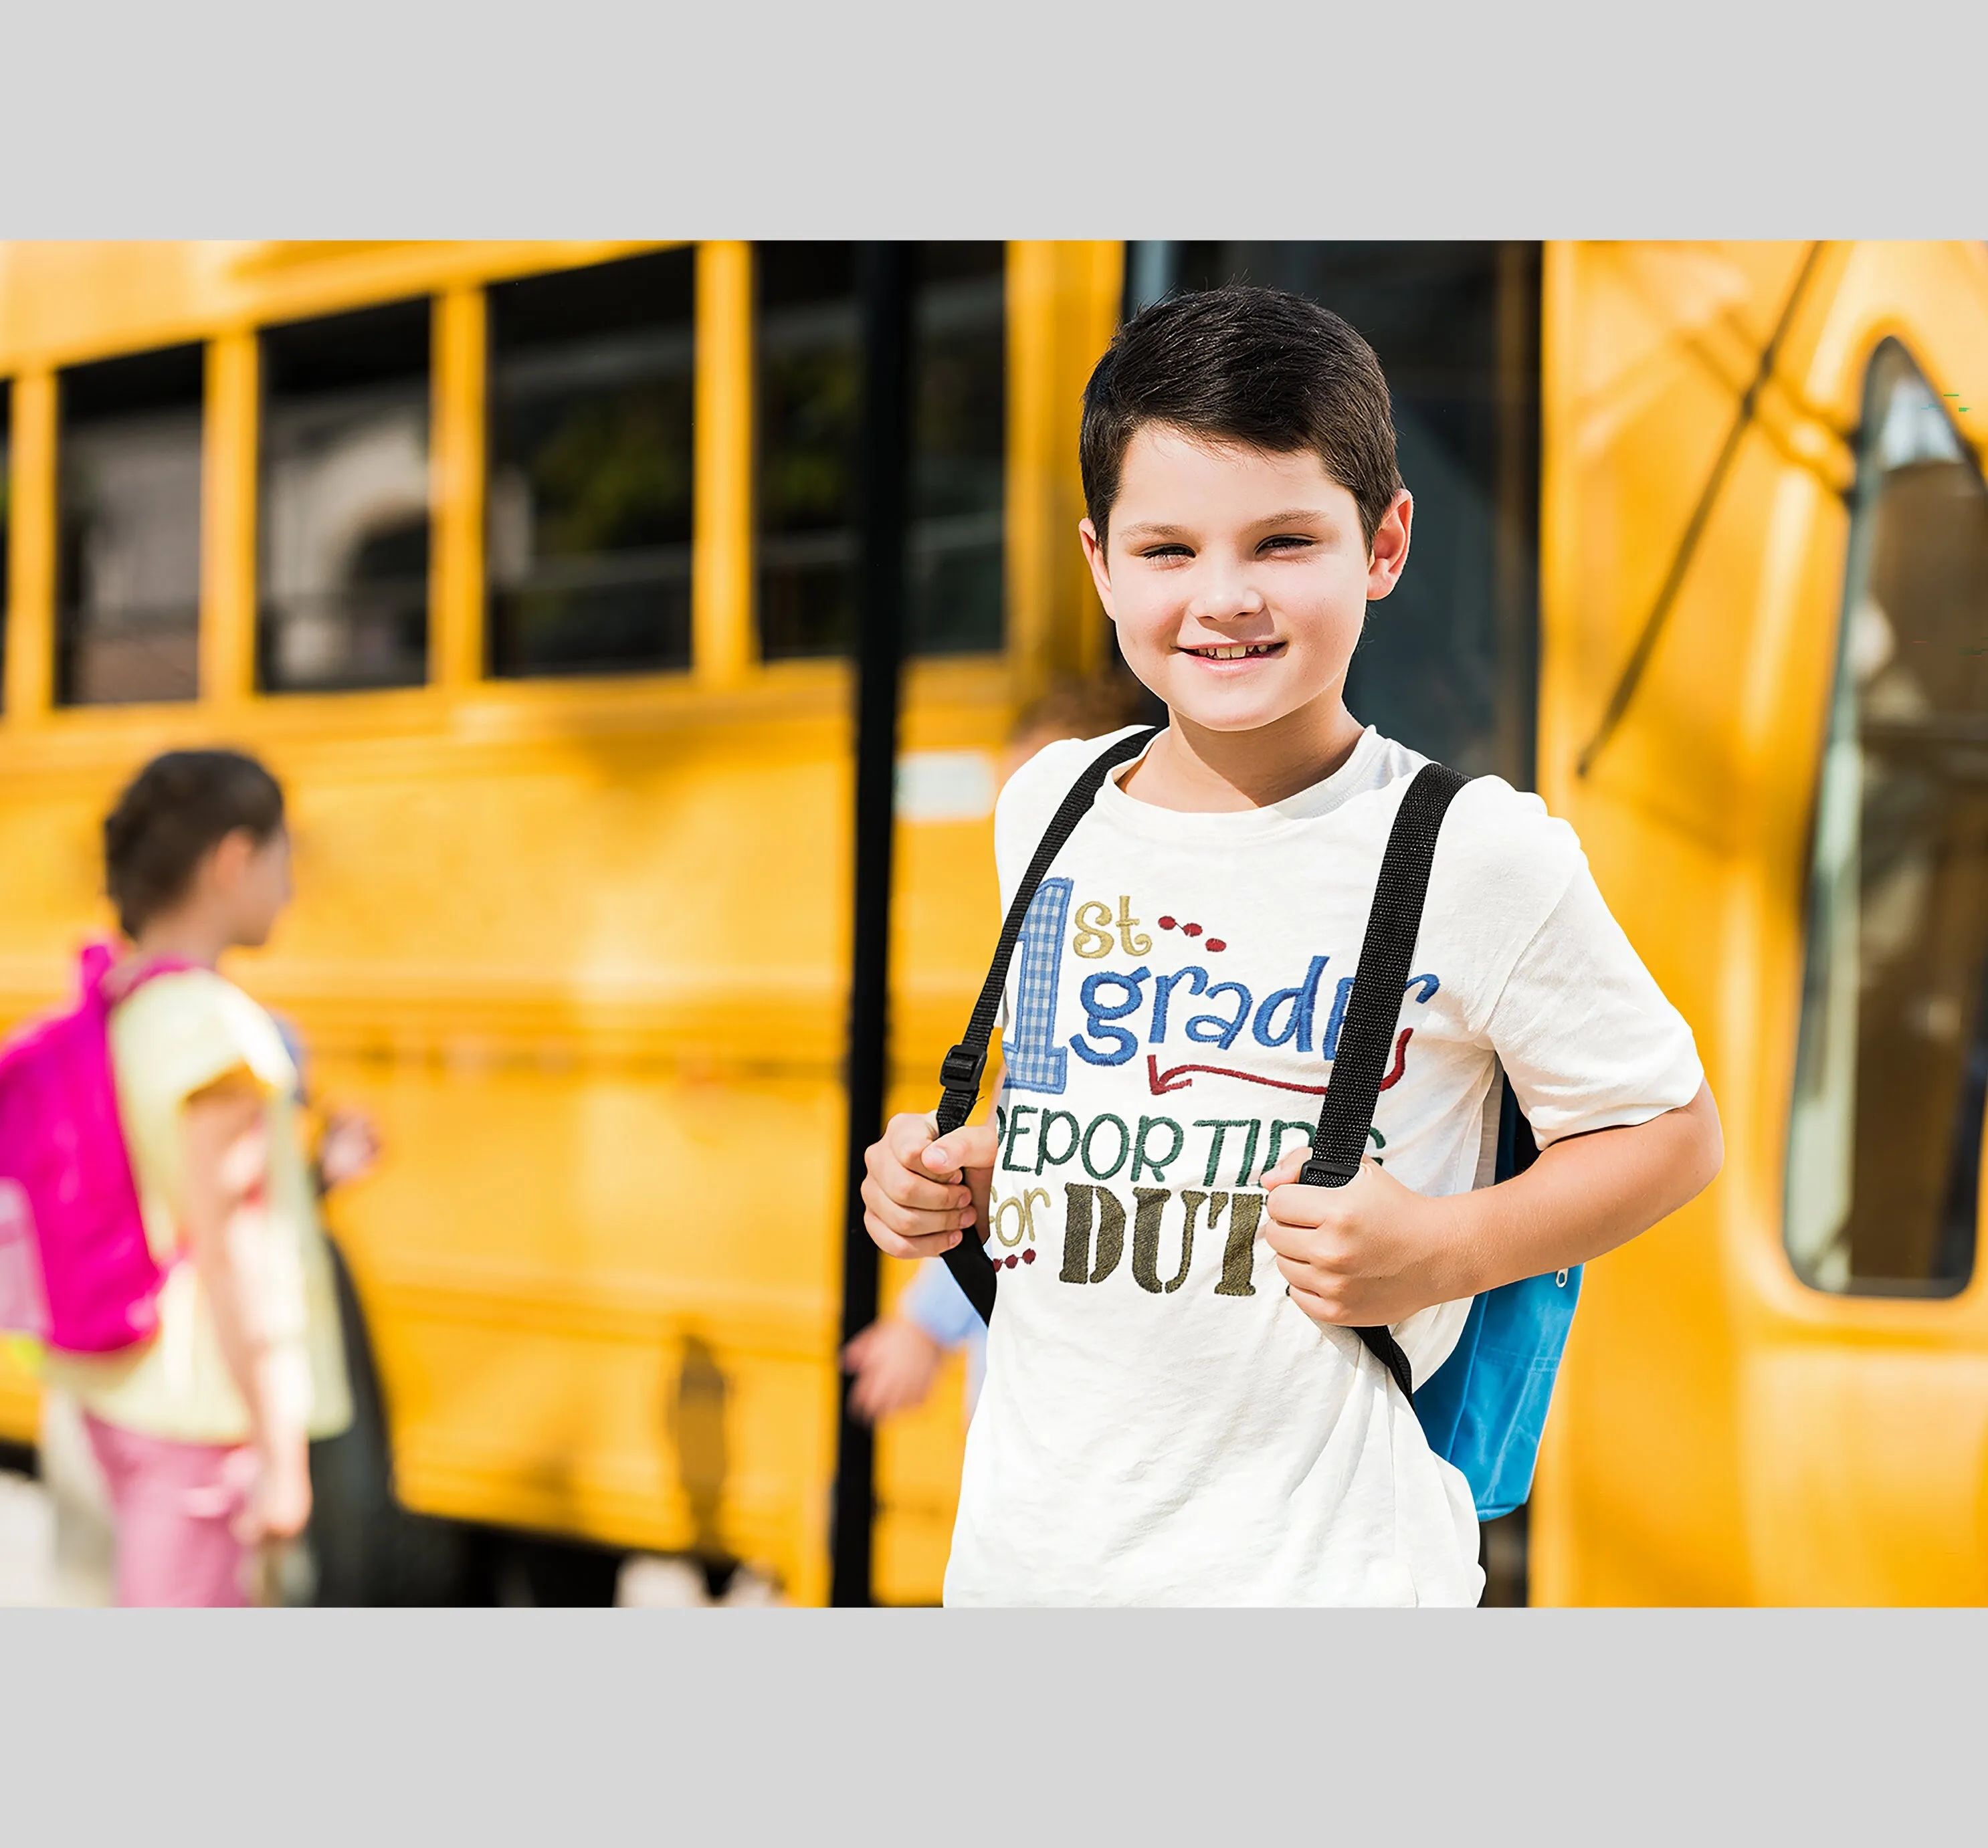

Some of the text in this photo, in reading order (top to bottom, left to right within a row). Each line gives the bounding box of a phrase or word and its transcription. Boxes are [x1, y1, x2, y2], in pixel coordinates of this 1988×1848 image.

[997, 1105, 1386, 1187] EPORTIN
[990, 1182, 1292, 1296] or DUT
